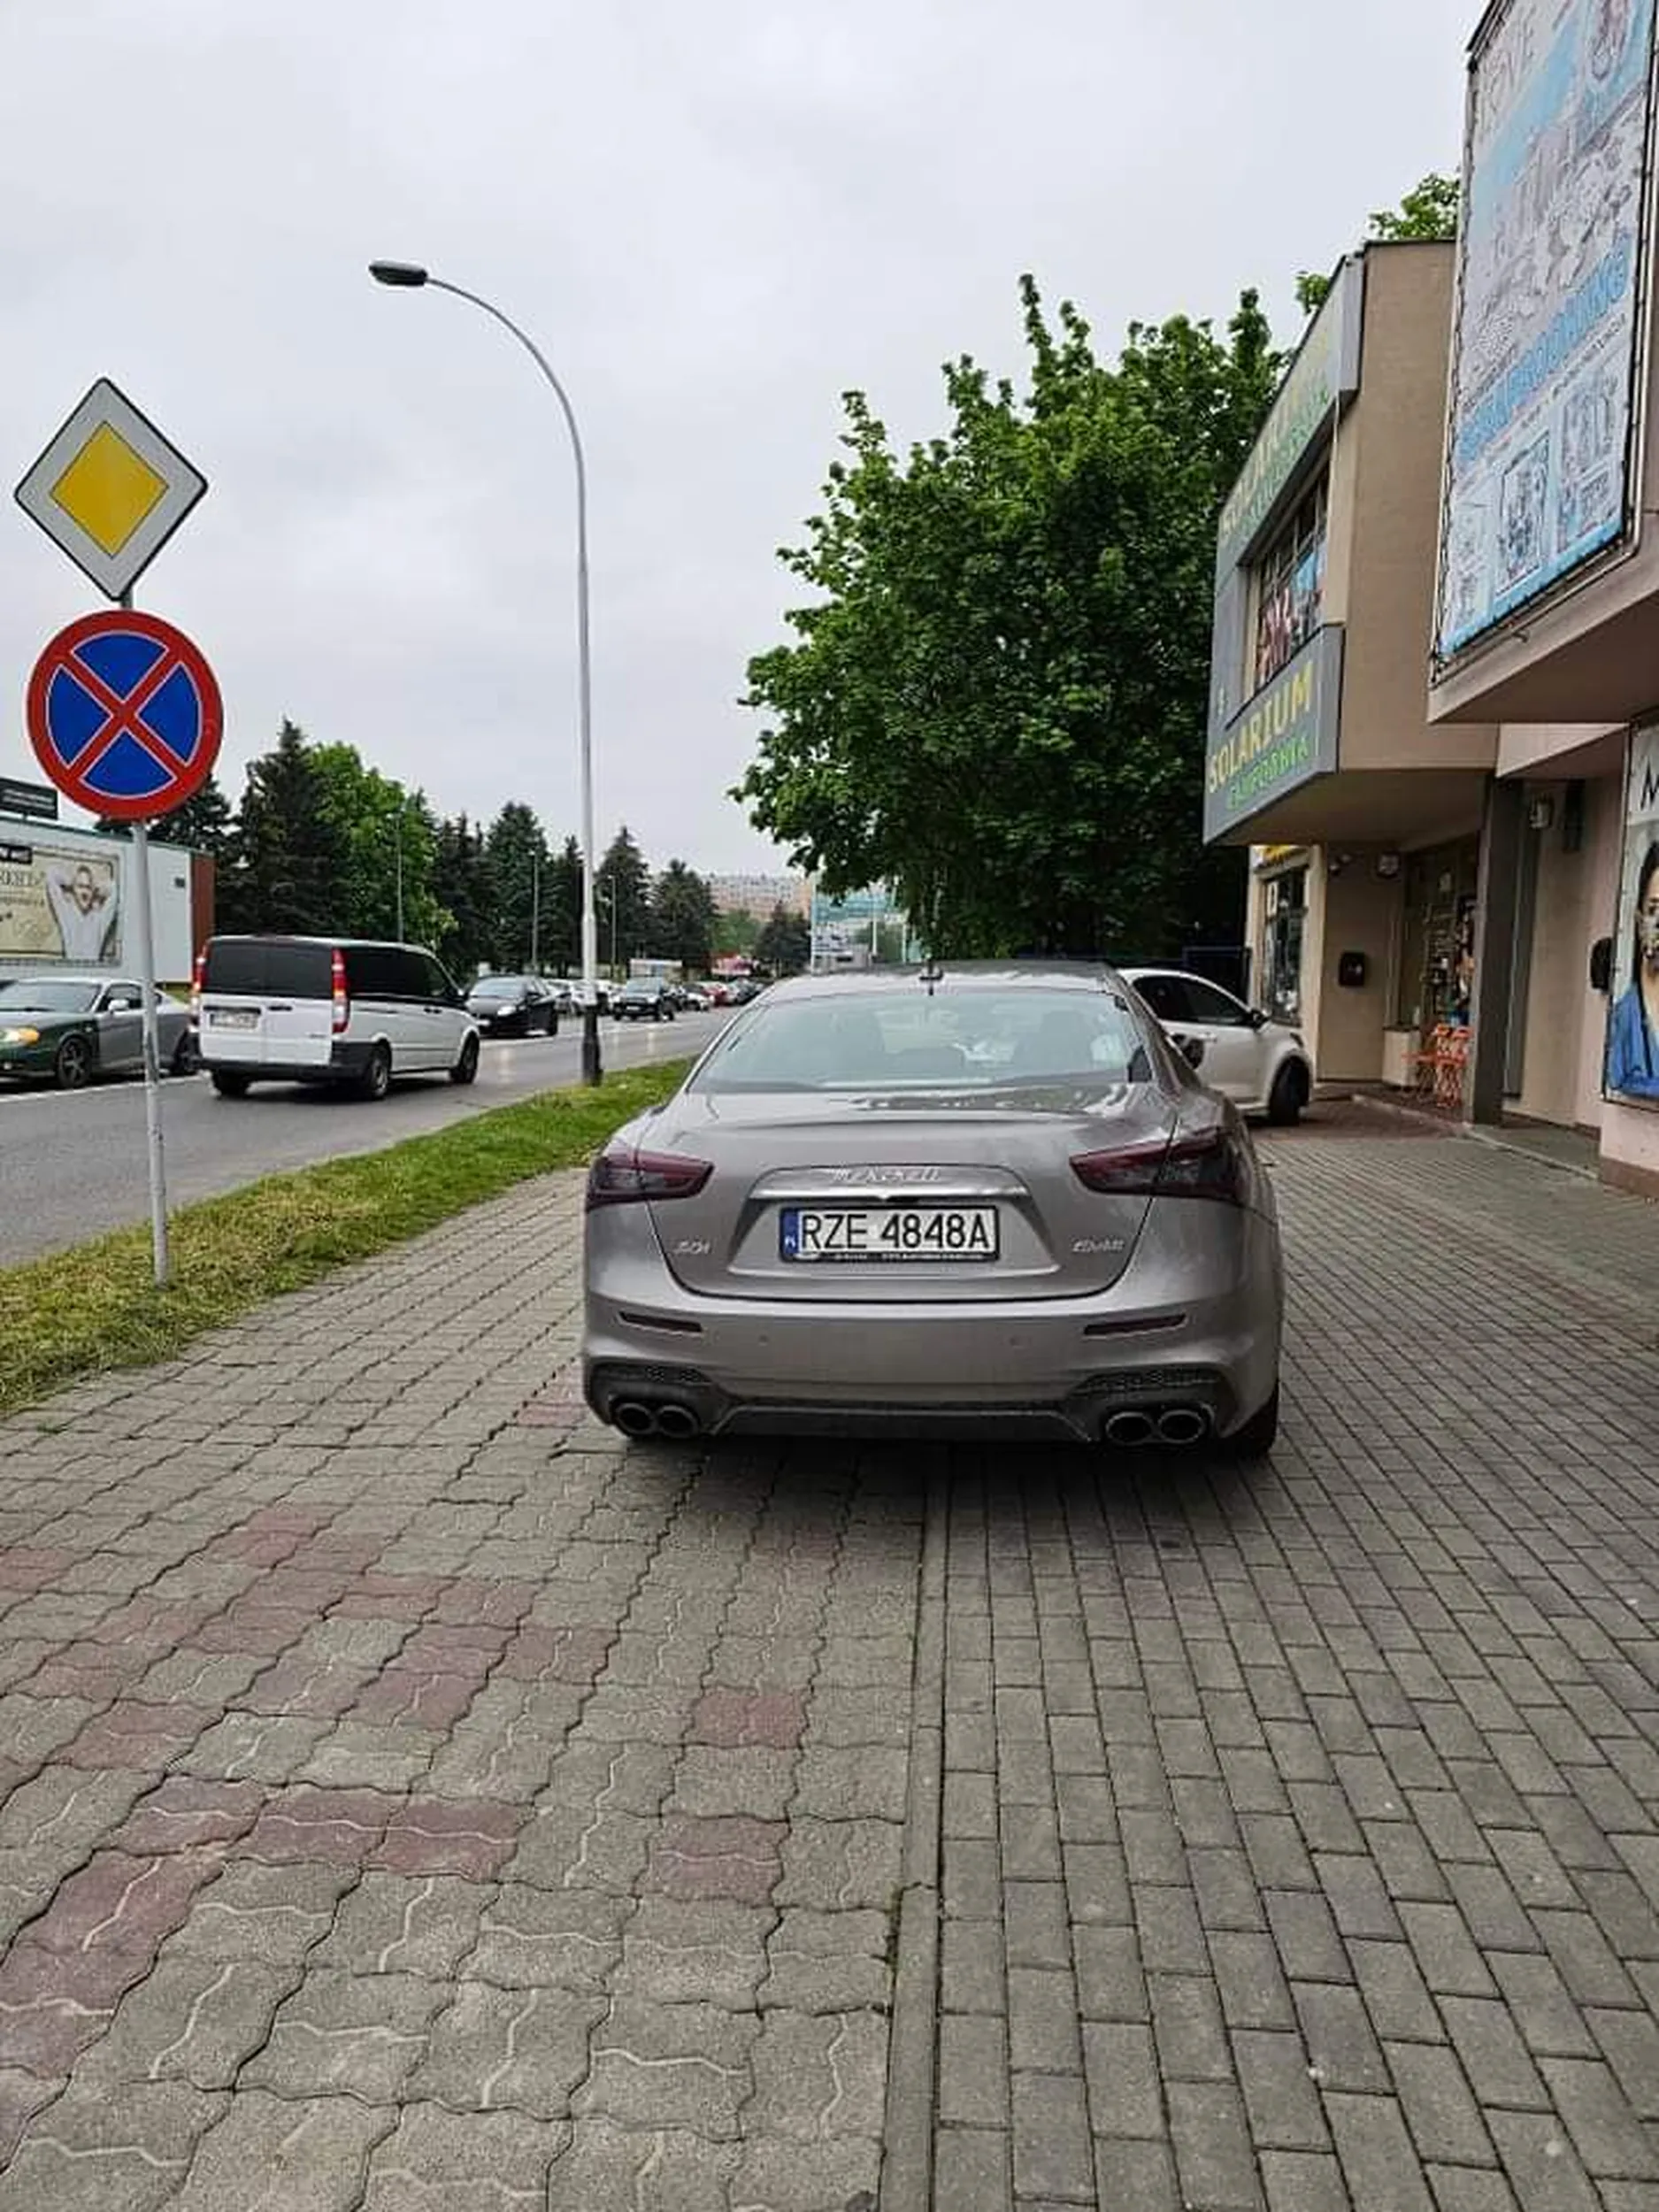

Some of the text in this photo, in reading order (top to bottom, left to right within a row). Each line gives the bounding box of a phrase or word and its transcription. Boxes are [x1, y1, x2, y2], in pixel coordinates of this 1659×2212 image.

[1209, 660, 1313, 794] SOLARIUM
[802, 1213, 989, 1249] RZE 4848A
